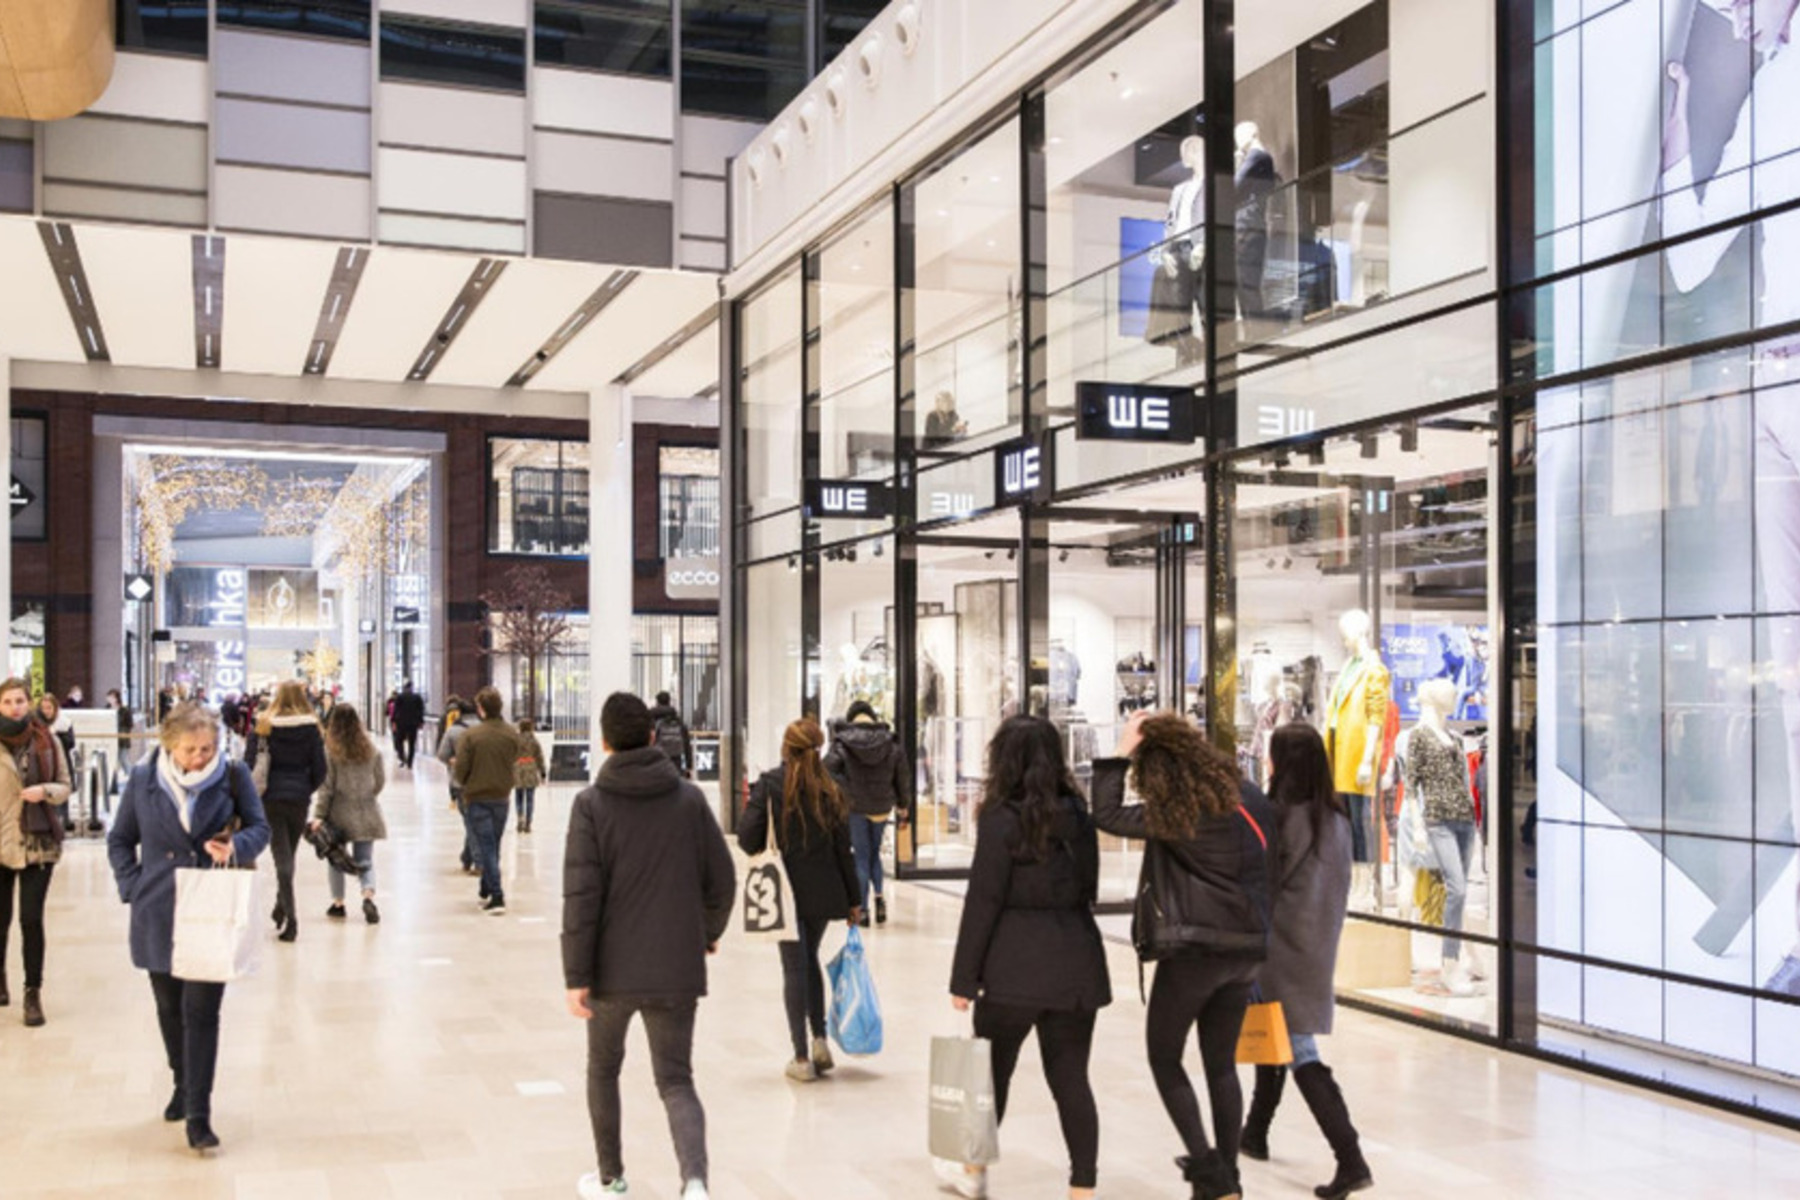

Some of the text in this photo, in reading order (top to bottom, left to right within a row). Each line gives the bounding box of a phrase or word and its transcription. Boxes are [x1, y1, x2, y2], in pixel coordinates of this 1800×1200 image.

[1108, 395, 1169, 430] WE
[1005, 447, 1040, 492] WE
[822, 487, 867, 511] WE
[669, 571, 720, 586] ecco
